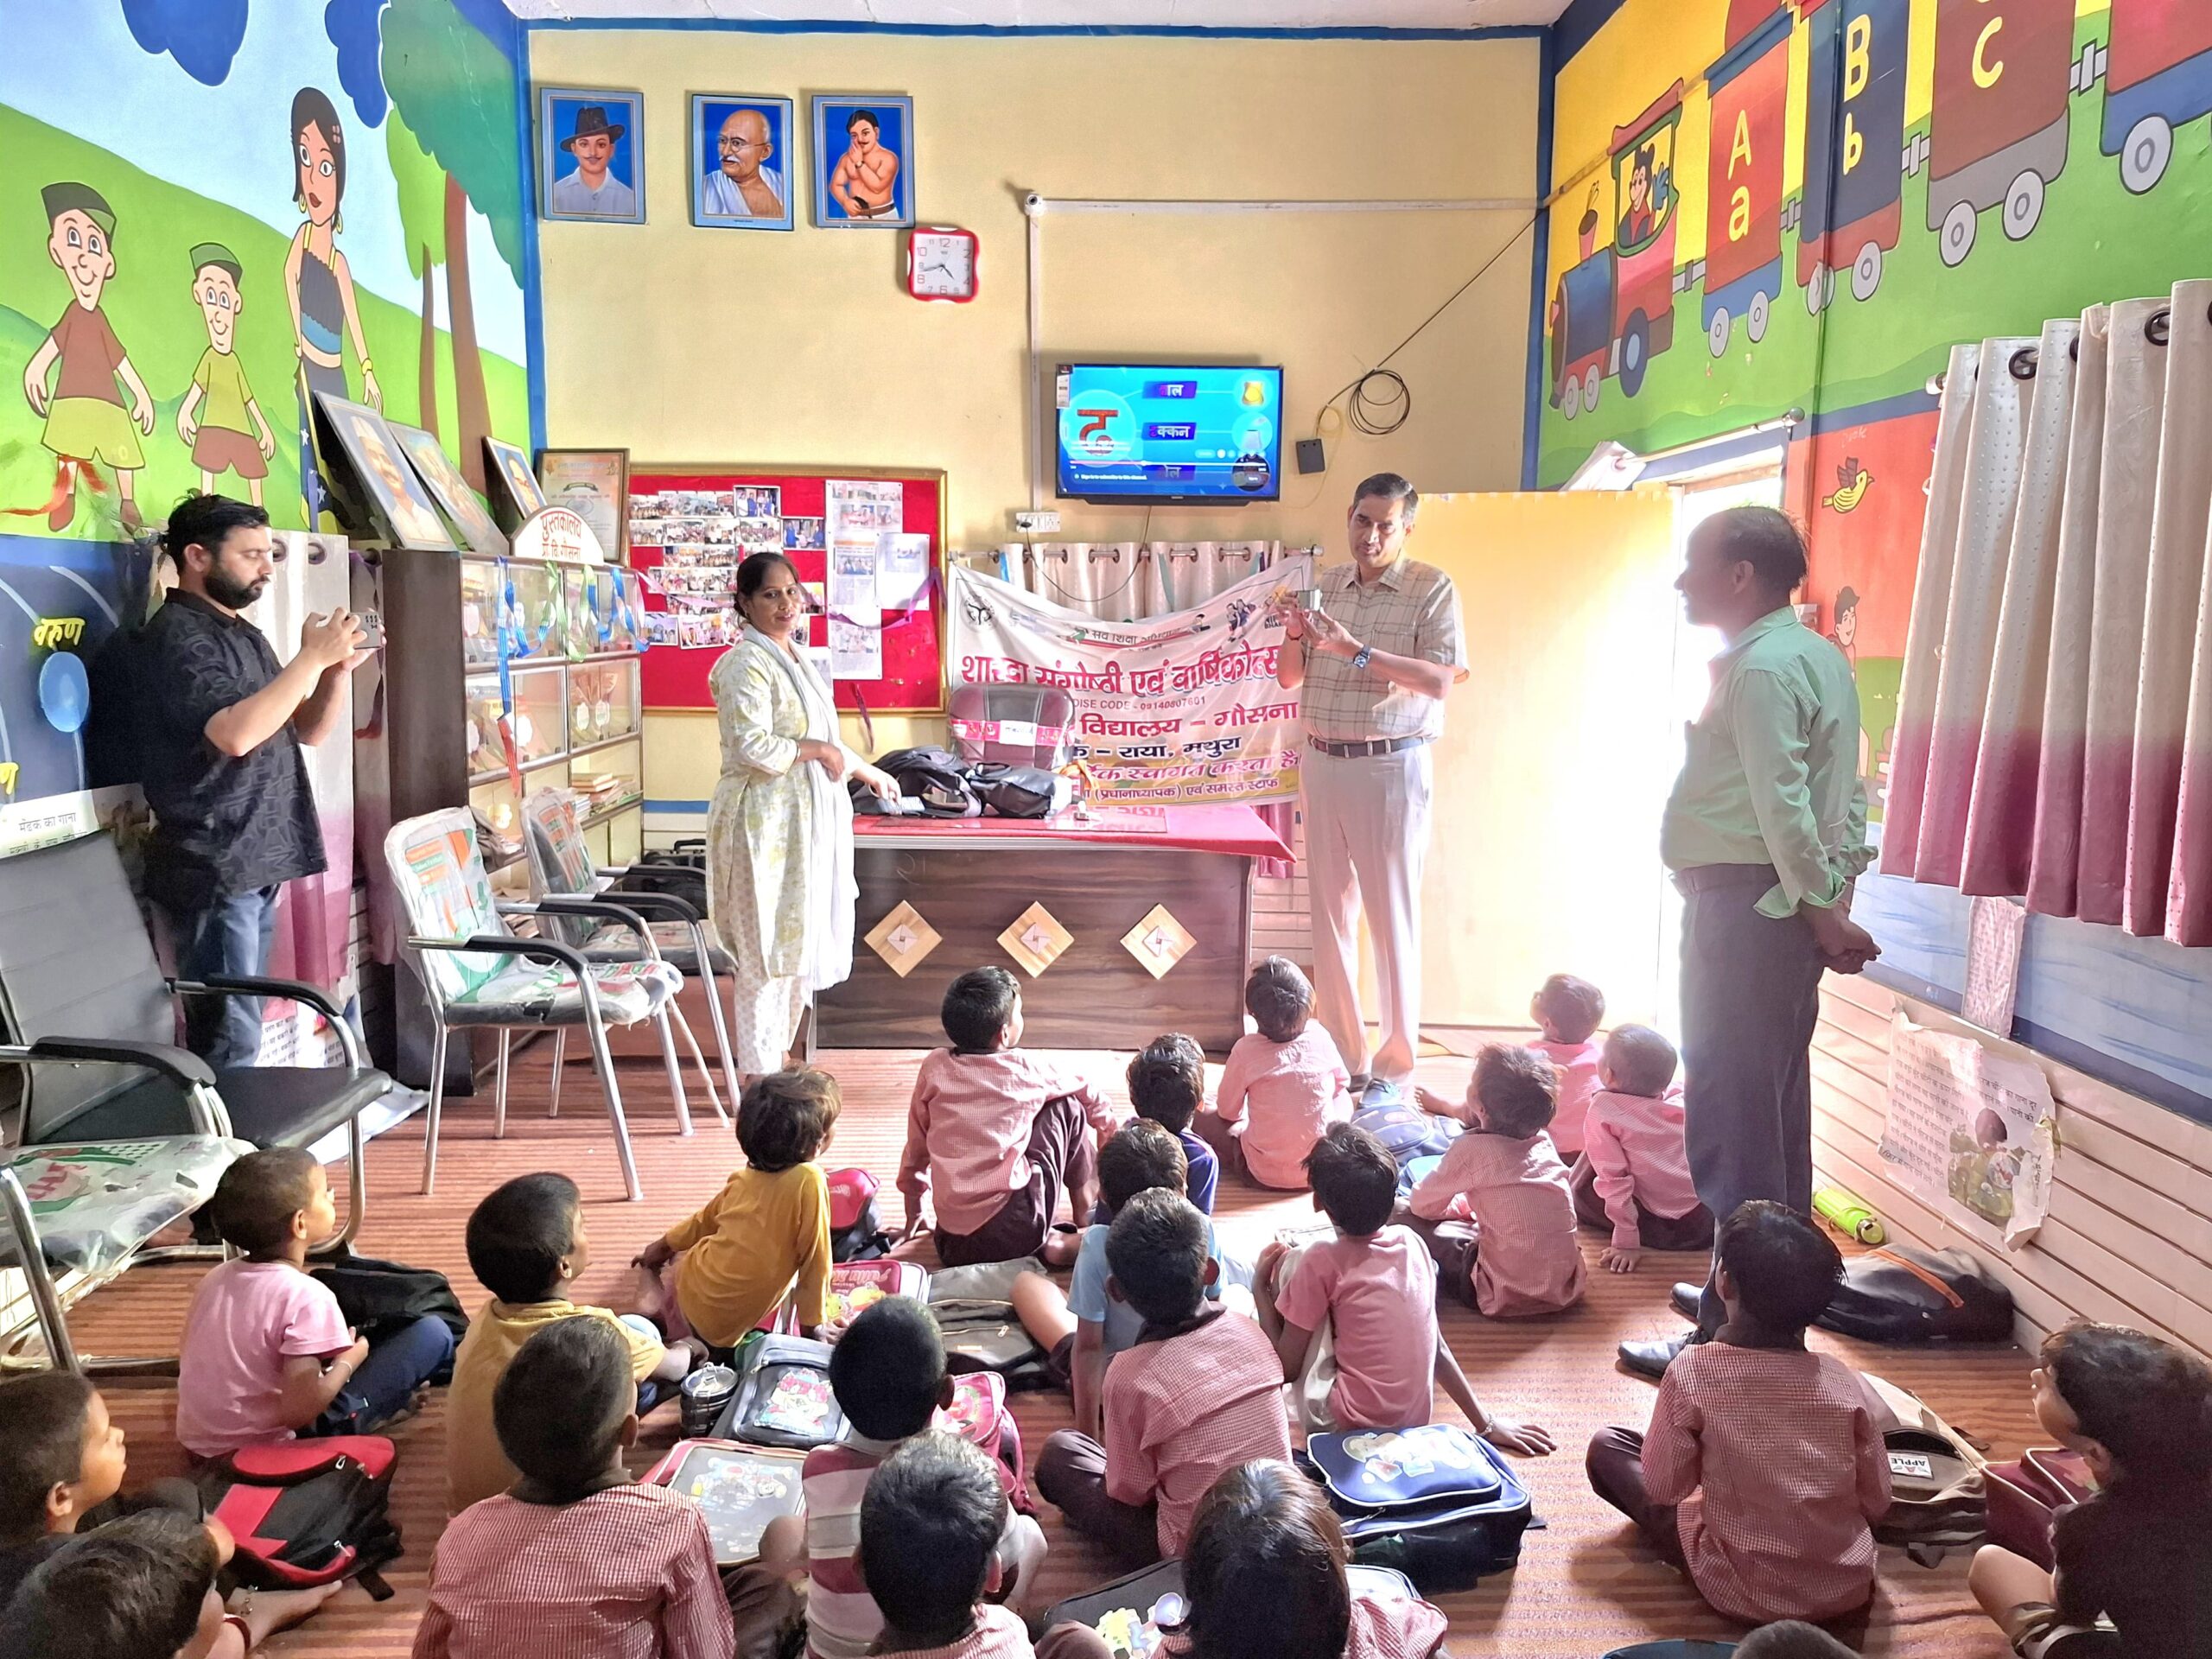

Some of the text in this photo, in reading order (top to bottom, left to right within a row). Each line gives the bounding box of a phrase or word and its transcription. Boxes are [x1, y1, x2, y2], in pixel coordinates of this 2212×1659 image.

[1842, 14, 1872, 104] B
[1727, 109, 1752, 180] A
[1842, 111, 1864, 175] b
[1728, 182, 1751, 243] a
[1129, 658, 1170, 697] एवं
[1073, 698, 1096, 709] DISE
[1100, 700, 1131, 710] CODE
[1079, 713, 1183, 737] विद्यालय
[1183, 737, 1242, 758] मथुरा
[1891, 1458, 1925, 1466] APPLE
